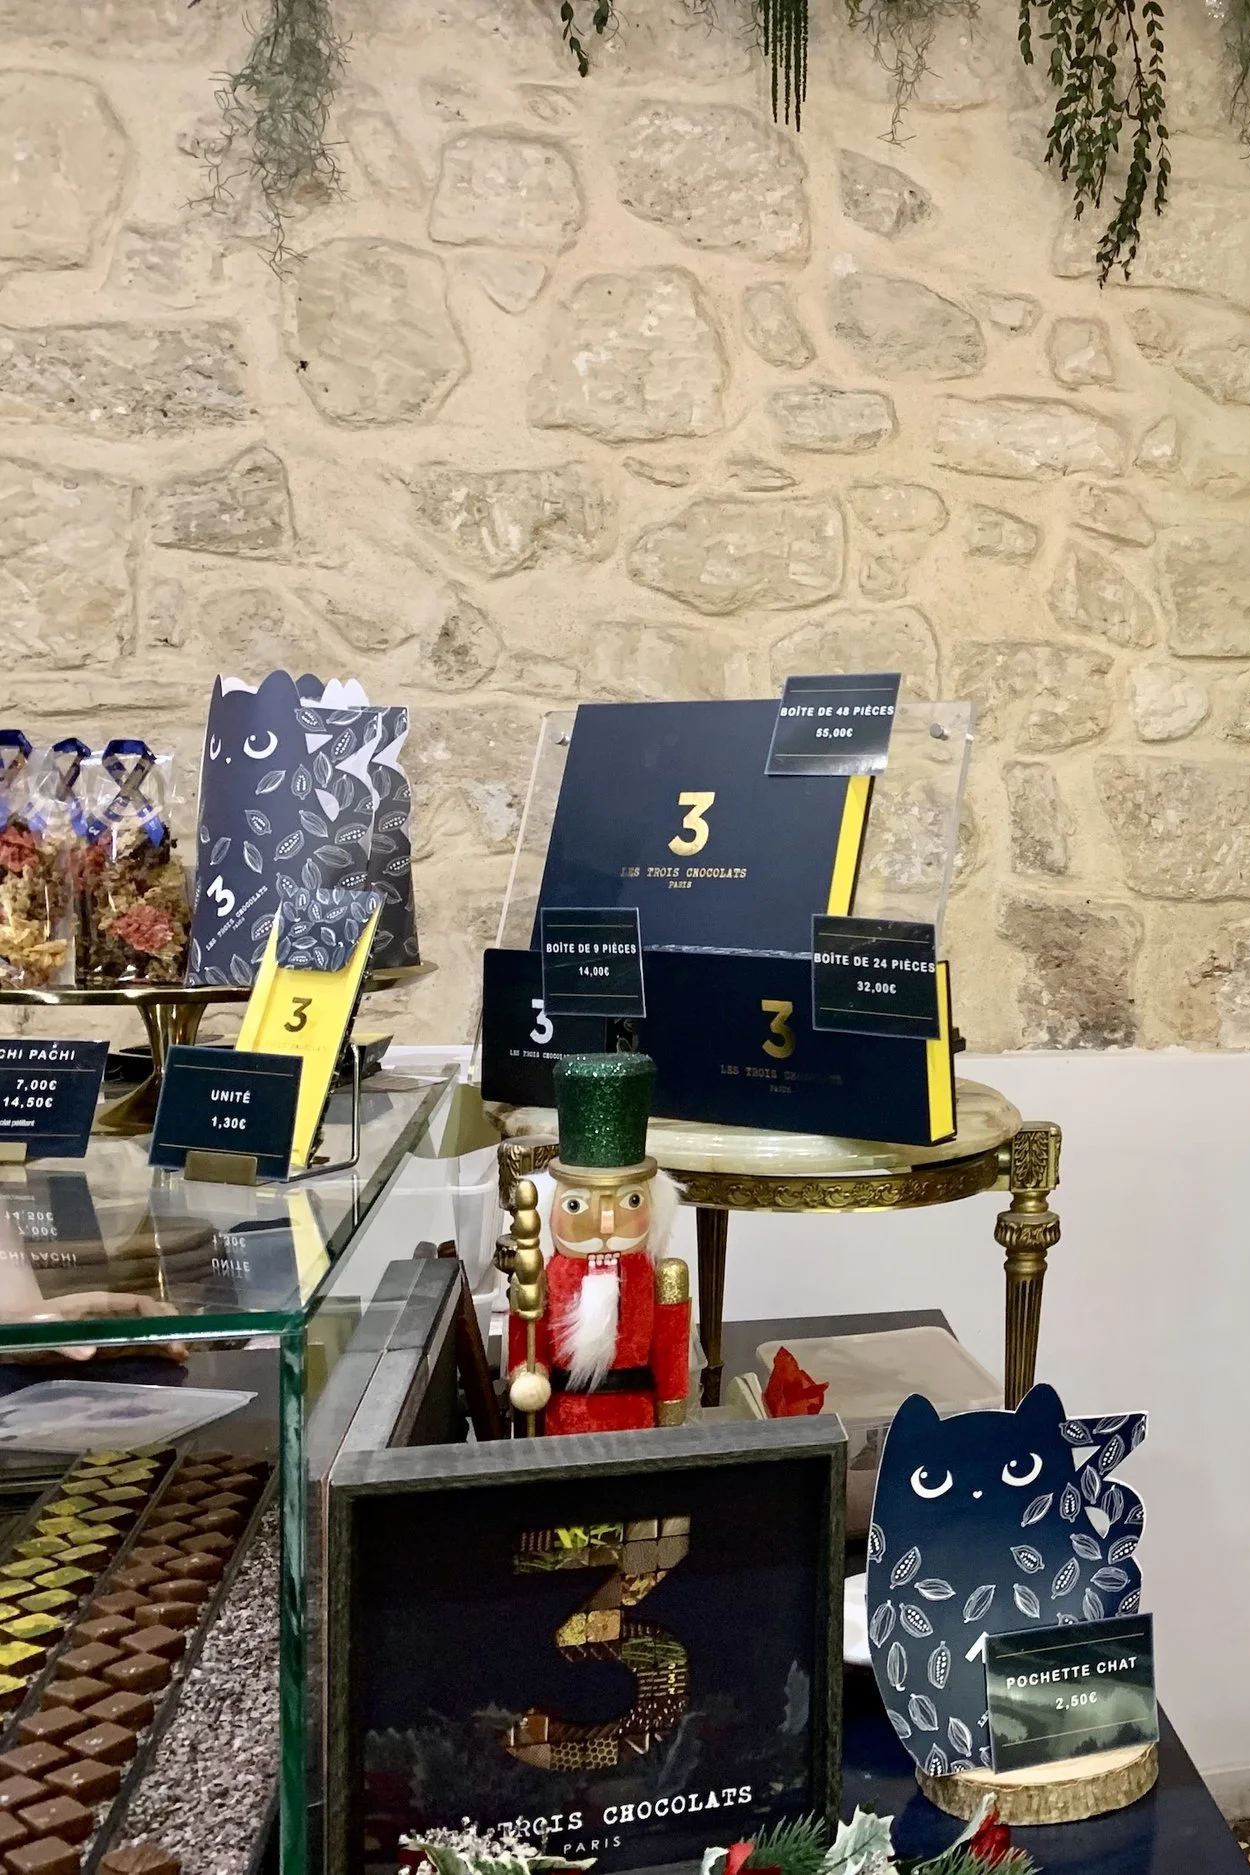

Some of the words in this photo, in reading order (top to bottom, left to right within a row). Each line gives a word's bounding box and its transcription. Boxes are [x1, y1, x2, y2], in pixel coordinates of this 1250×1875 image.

[780, 705, 814, 716] BOÎTE
[818, 707, 833, 716] DE
[836, 706, 850, 716] 48
[853, 704, 894, 716] PIÈCES
[815, 728, 853, 738] 55,00€
[668, 791, 715, 856] 3
[620, 866, 640, 877] LES
[646, 867, 680, 878] TROIS
[686, 867, 747, 879] CHOCOLATS
[668, 880, 692, 889] PARIS
[206, 875, 235, 917] 3
[235, 885, 268, 918] CHOCOLATS
[578, 943, 591, 953] DE
[593, 943, 600, 953] 9
[602, 942, 637, 954] PIÈCES
[578, 966, 610, 977] 14,00€
[853, 956, 870, 967] DE
[873, 958, 888, 969] 24
[891, 958, 936, 973] PIÈCES
[856, 980, 897, 994] 32,00€
[284, 996, 313, 1033] 3
[529, 998, 554, 1044] 3
[761, 999, 795, 1058] 3
[29, 1049, 75, 1060] PACHI
[720, 1064, 740, 1075] LES
[745, 1066, 778, 1079] TROIS
[16, 1079, 57, 1091] 7,00€
[3, 1096, 53, 1108] 14,50€
[211, 1089, 251, 1104] UNITÉ
[211, 1116, 247, 1130] 1,30€
[505, 1513, 692, 1772] 3
[1007, 1664, 1091, 1690] POCHETTE
[1096, 1656, 1137, 1675] CHAT
[1055, 1691, 1098, 1711] 2,50€
[602, 1785, 753, 1825] CHOCOLATS
[563, 1835, 622, 1855] PARIS
